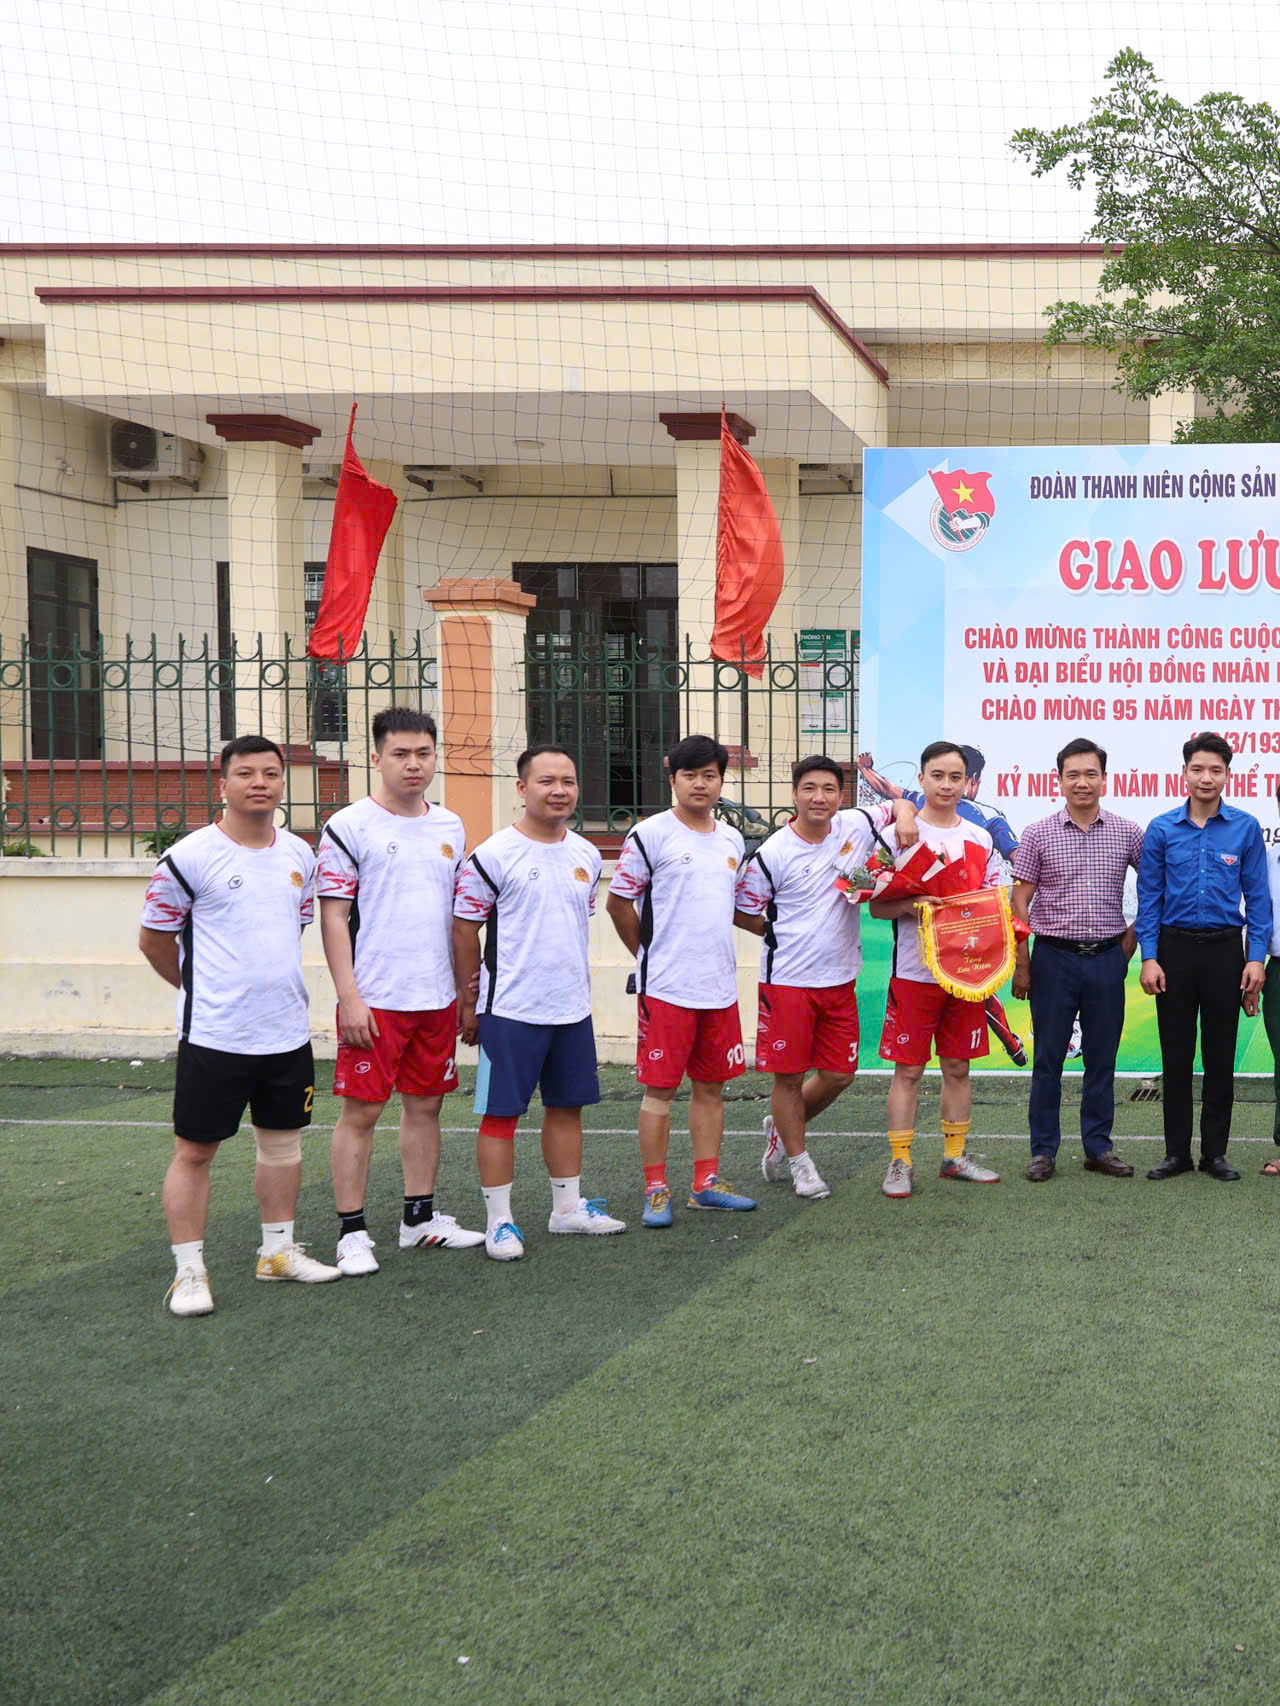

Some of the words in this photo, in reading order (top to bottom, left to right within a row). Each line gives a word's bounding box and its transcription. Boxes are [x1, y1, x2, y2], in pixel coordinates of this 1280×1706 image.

[1030, 470, 1077, 500] ĐOÀN
[1081, 474, 1138, 499] THANH
[1142, 469, 1184, 499] NIÊN
[1189, 468, 1236, 504] CỘNG
[1240, 465, 1276, 498] SẢN
[1059, 539, 1183, 591] GIAO
[964, 621, 1019, 649] CHÀO
[1025, 621, 1087, 649] MỪNG
[1093, 621, 1161, 649] THÀNH
[1167, 623, 1223, 649] CÔNG
[983, 656, 1009, 683] VÀ
[1015, 661, 1049, 689] ĐẠI
[1055, 652, 1103, 684] BIỂU
[1109, 657, 1143, 689] HỘI
[1148, 653, 1206, 683] ĐỒNG
[1213, 657, 1270, 684] NHÂN
[981, 694, 1037, 721] CHÀO
[1043, 694, 1106, 721] MỪNG
[1112, 698, 1137, 721] 95
[1144, 694, 1193, 721] NĂM
[1199, 694, 1256, 721] NGÀY
[997, 765, 1021, 797] KỶ
[1027, 768, 1066, 802] NIỆ
[1113, 769, 1158, 797] NĂM
[1165, 773, 1191, 797] NG
[969, 1027, 982, 1049] 11
[443, 1057, 456, 1081] 2
[726, 1043, 744, 1069] 90
